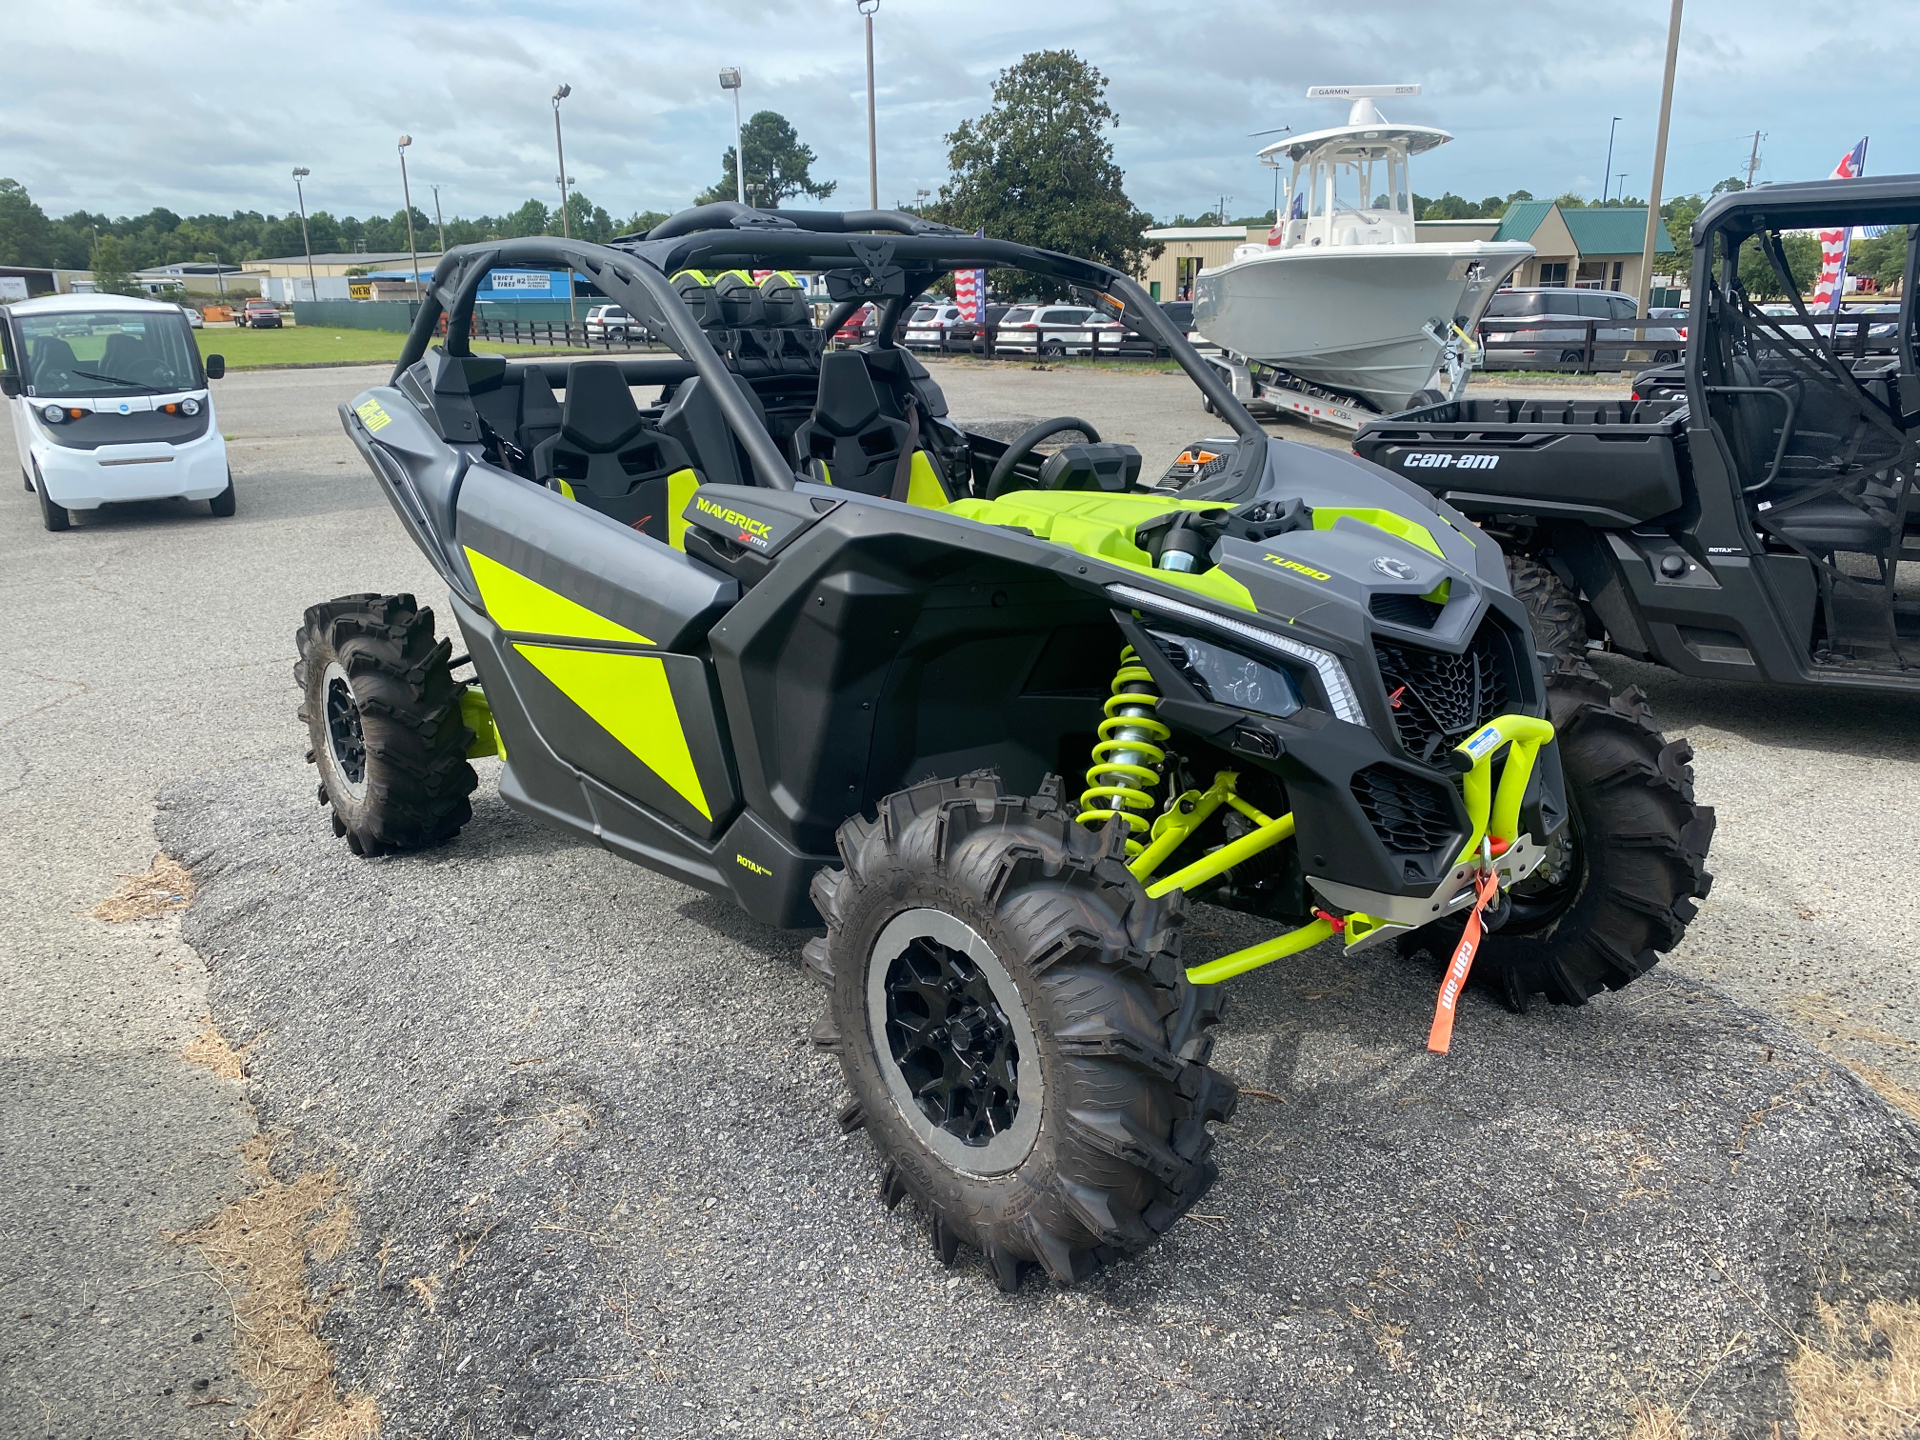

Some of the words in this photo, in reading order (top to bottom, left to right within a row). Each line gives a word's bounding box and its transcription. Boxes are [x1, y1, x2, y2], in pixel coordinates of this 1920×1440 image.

[1403, 453, 1500, 469] can-am
[696, 496, 773, 539] MAVERICK
[1263, 553, 1331, 581] TURBO
[736, 854, 762, 875] ROTAX
[1442, 940, 1473, 1010] can-am
[902, 1157, 935, 1191] ITP
